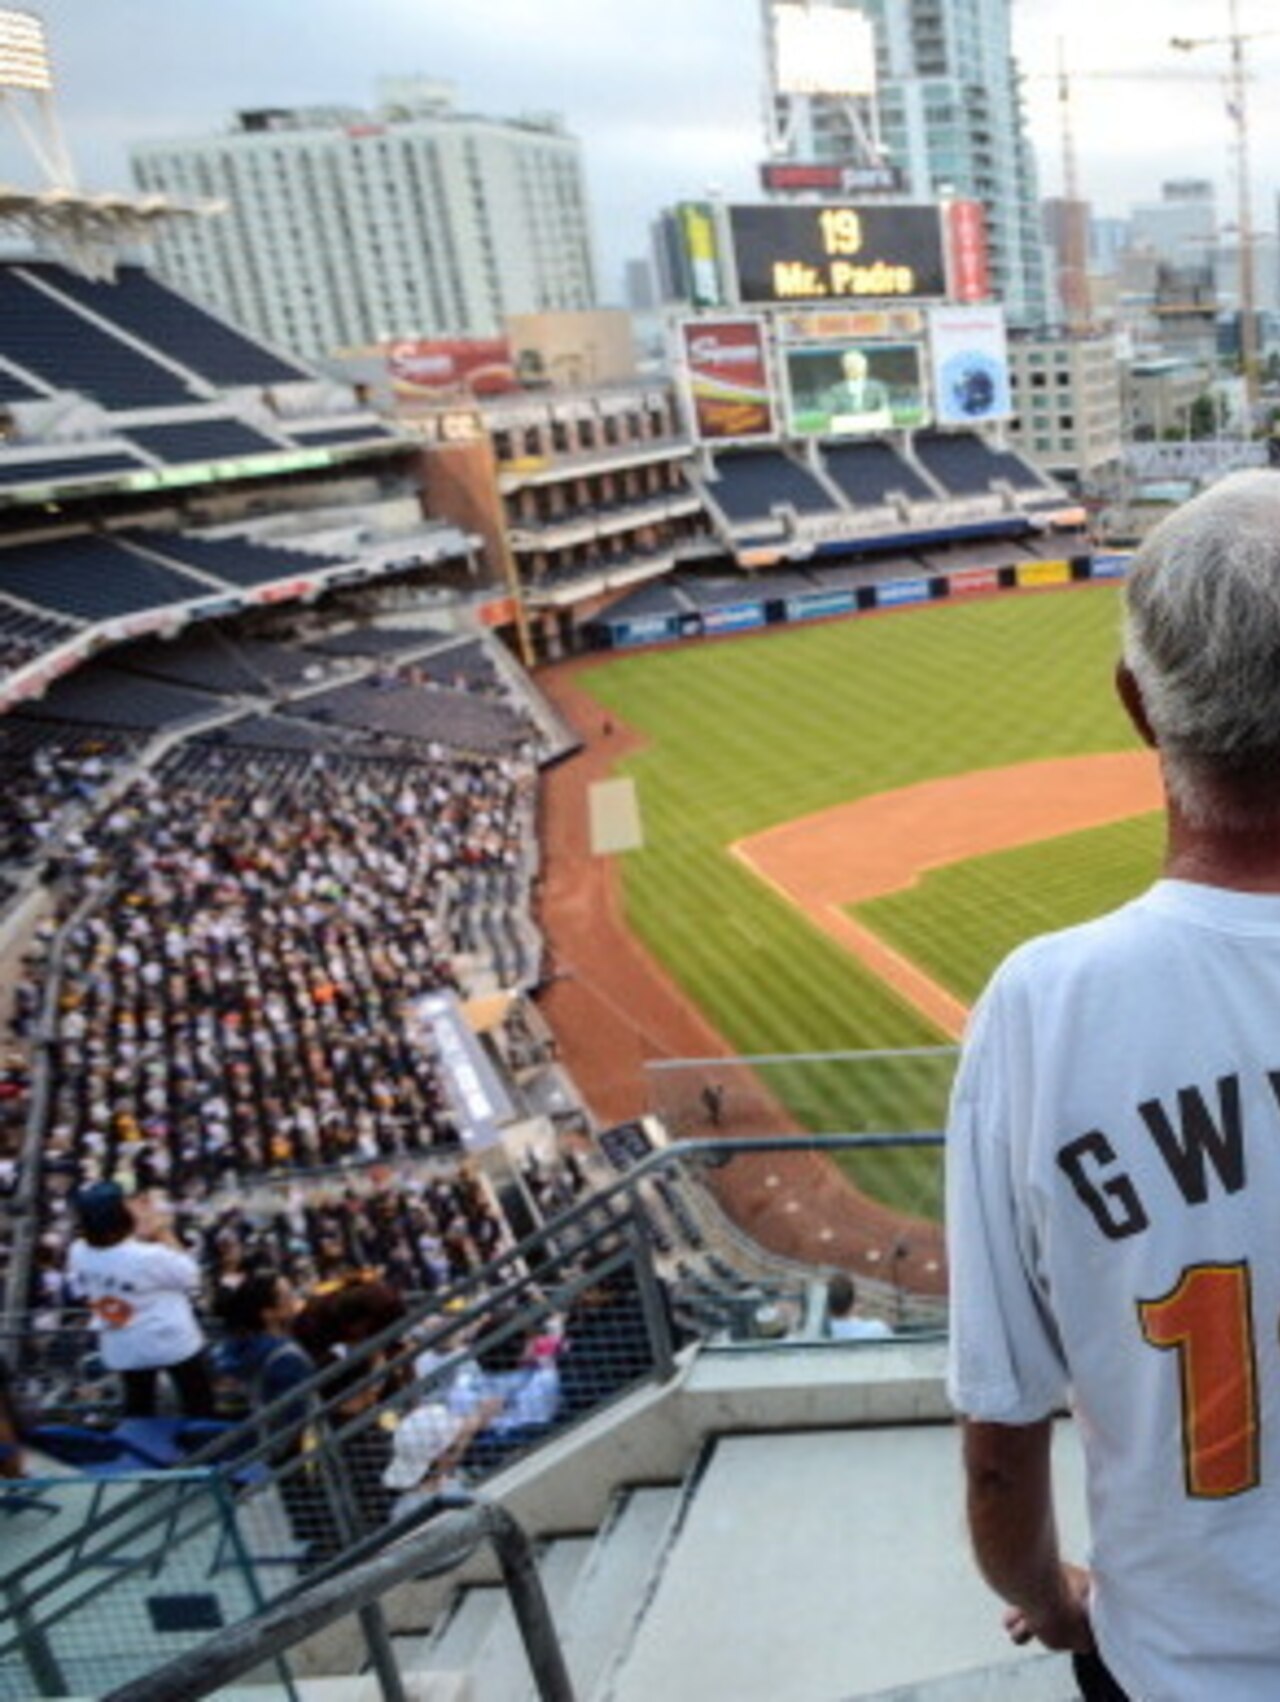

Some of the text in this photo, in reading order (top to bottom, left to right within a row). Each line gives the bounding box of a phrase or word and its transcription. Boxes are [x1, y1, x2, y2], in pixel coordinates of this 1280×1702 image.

[819, 208, 863, 256] 19
[774, 260, 914, 296] Mr. Padre
